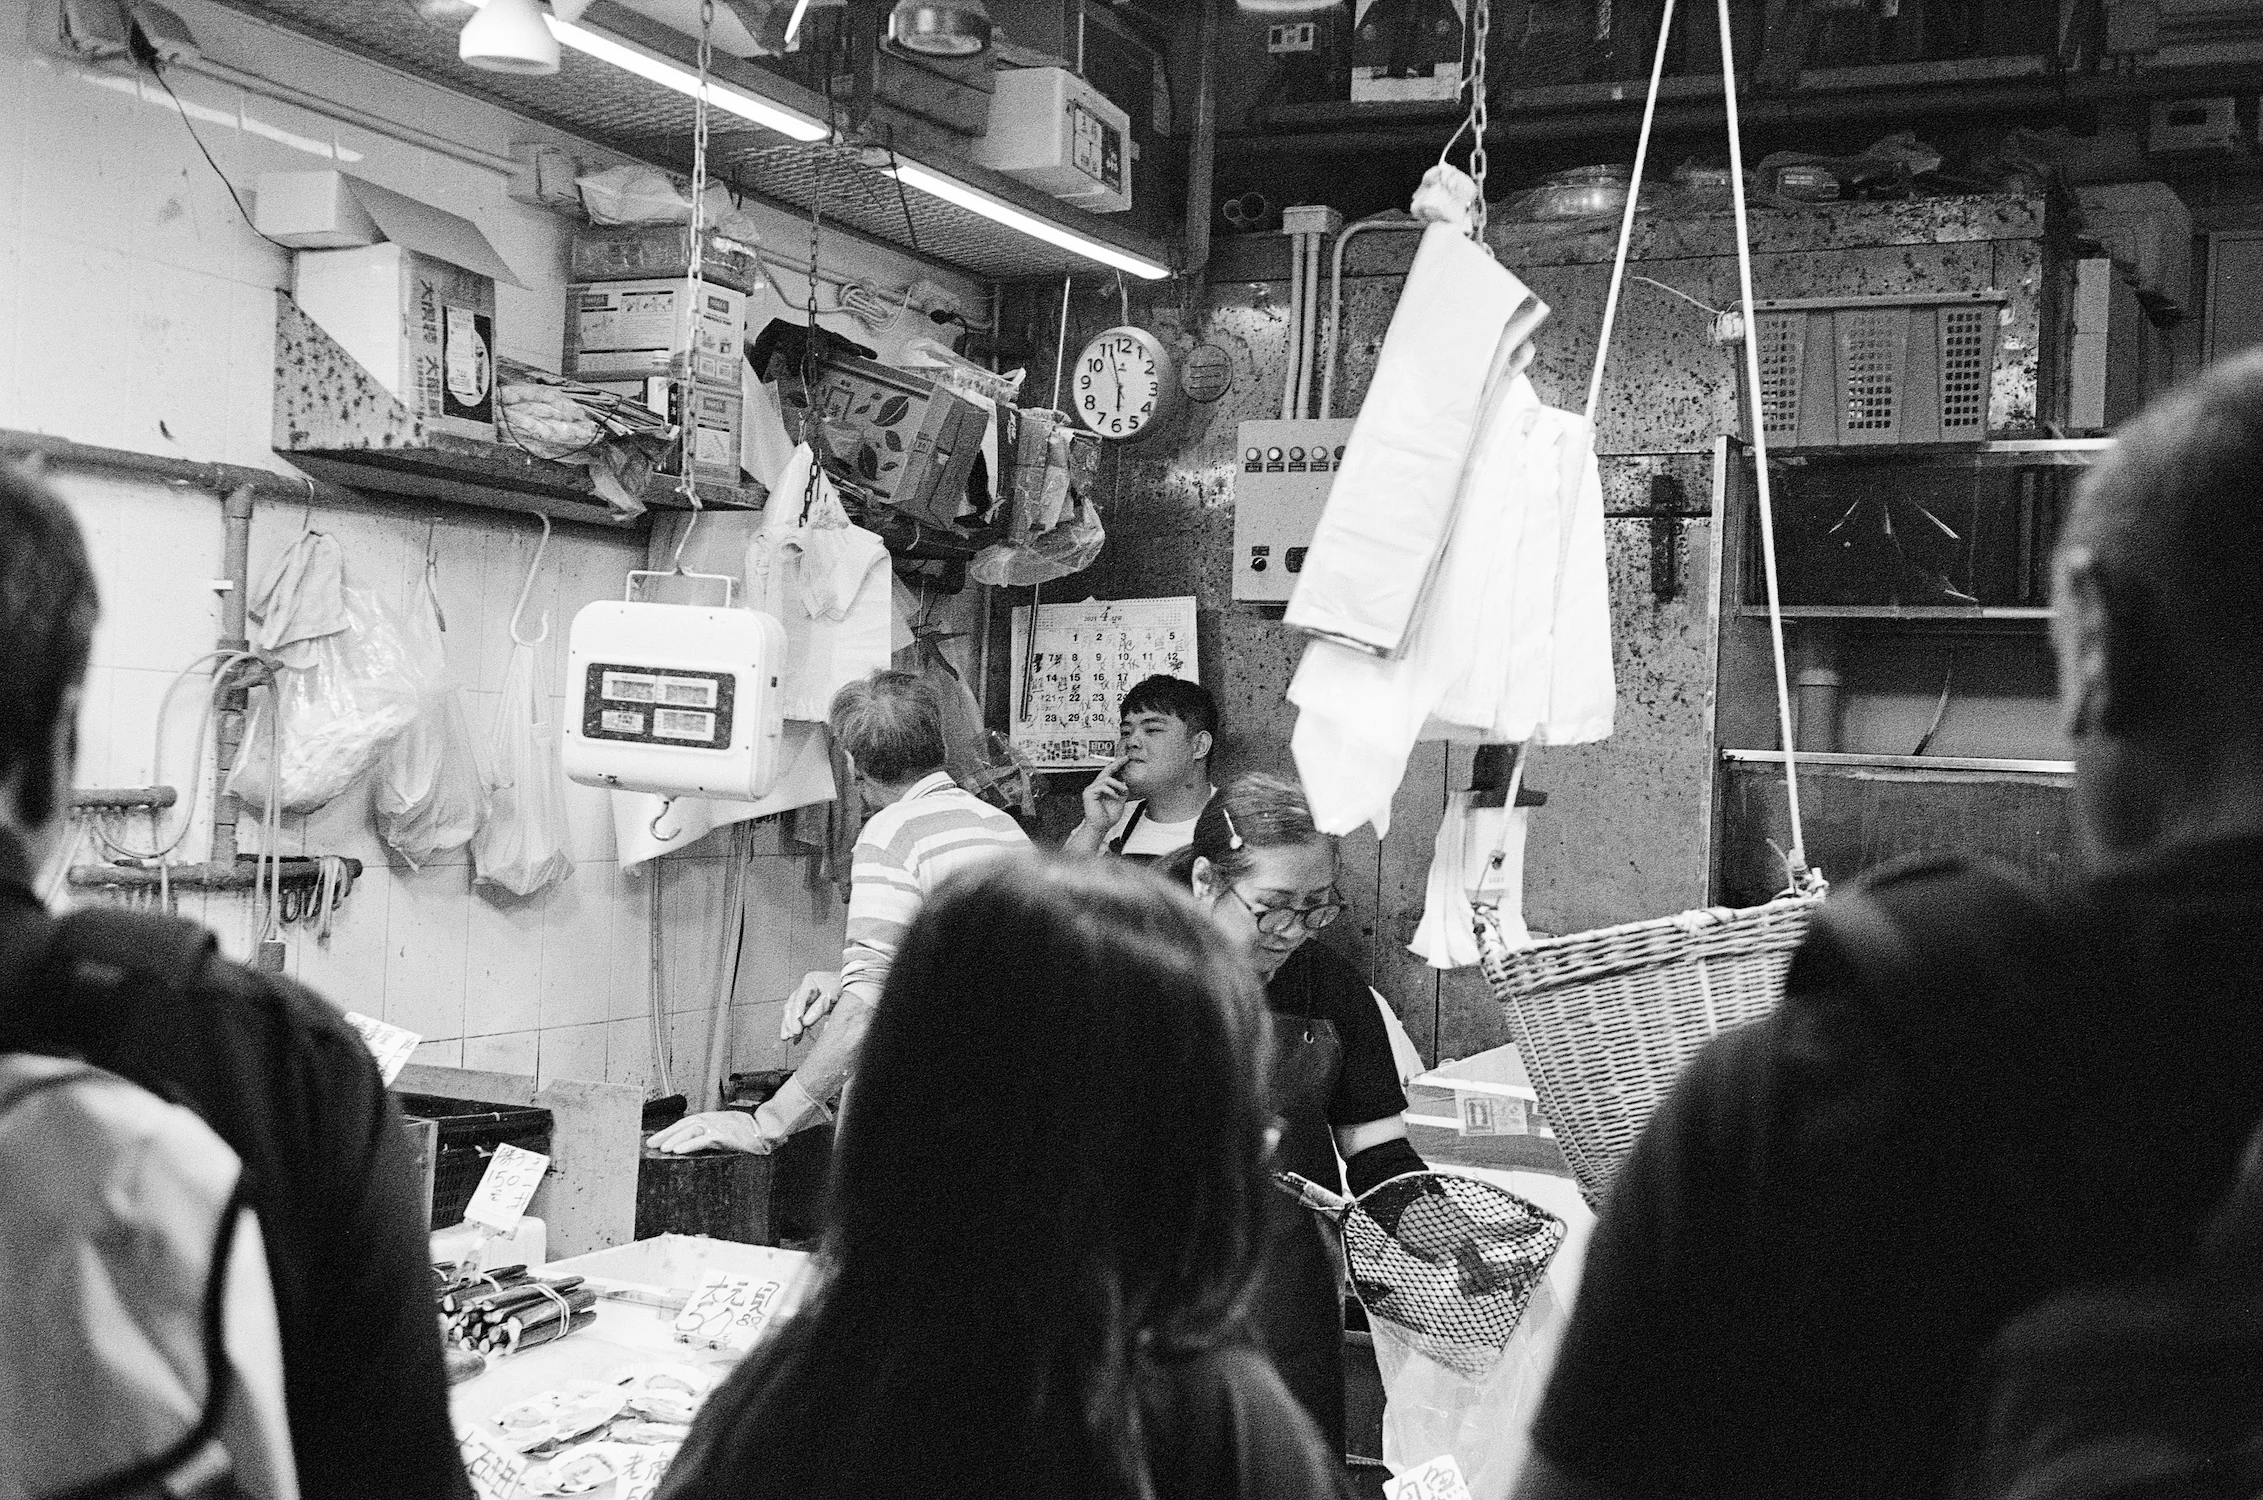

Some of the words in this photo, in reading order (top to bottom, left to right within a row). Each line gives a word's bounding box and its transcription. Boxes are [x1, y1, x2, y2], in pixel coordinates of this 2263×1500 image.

[1100, 343, 1114, 357] 11
[1116, 338, 1132, 353] 12
[1137, 345, 1143, 359] 1
[1087, 358, 1103, 372] 10
[1144, 360, 1155, 374] 2
[1080, 375, 1091, 389] 9
[1148, 381, 1158, 396] 3
[1084, 394, 1095, 410] 8
[1140, 401, 1153, 416] 4
[1097, 411, 1107, 425] 7
[1111, 418, 1122, 432] 6
[1128, 415, 1139, 429] 5
[1099, 606, 1111, 622] 4
[1073, 633, 1078, 641] 1
[1096, 633, 1102, 641] 2
[1120, 633, 1126, 641] 3
[1169, 632, 1175, 640] 5
[1072, 653, 1078, 661] 8
[1096, 653, 1102, 661] 9
[1167, 653, 1178, 661] 12
[1046, 674, 1057, 682] 14
[1093, 673, 1104, 681] 16
[1117, 673, 1128, 681] 17
[1092, 713, 1104, 721] 30
[487, 1169, 520, 1188] 150
[675, 1300, 734, 1338] 50
